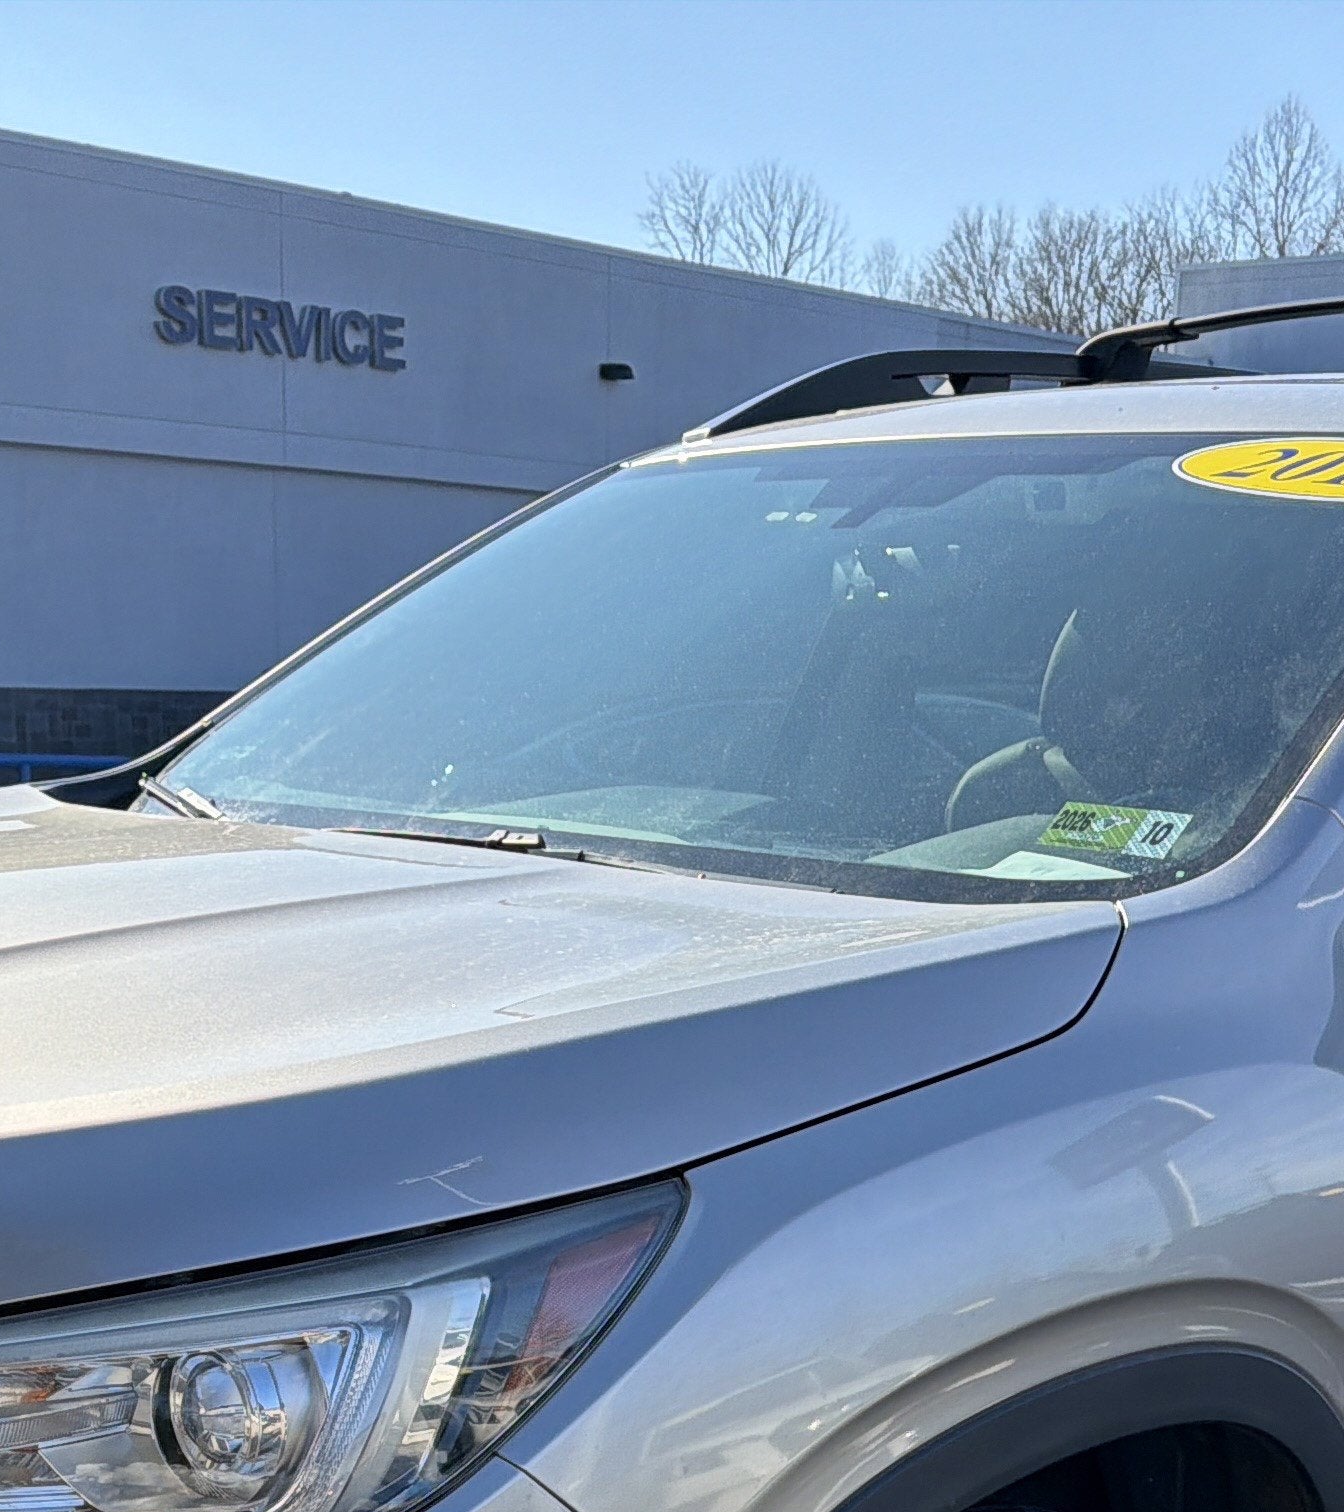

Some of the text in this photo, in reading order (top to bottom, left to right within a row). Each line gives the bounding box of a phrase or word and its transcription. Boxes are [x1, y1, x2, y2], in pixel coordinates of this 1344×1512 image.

[152, 284, 407, 372] SERVICE
[1051, 808, 1175, 846] 2026 10
